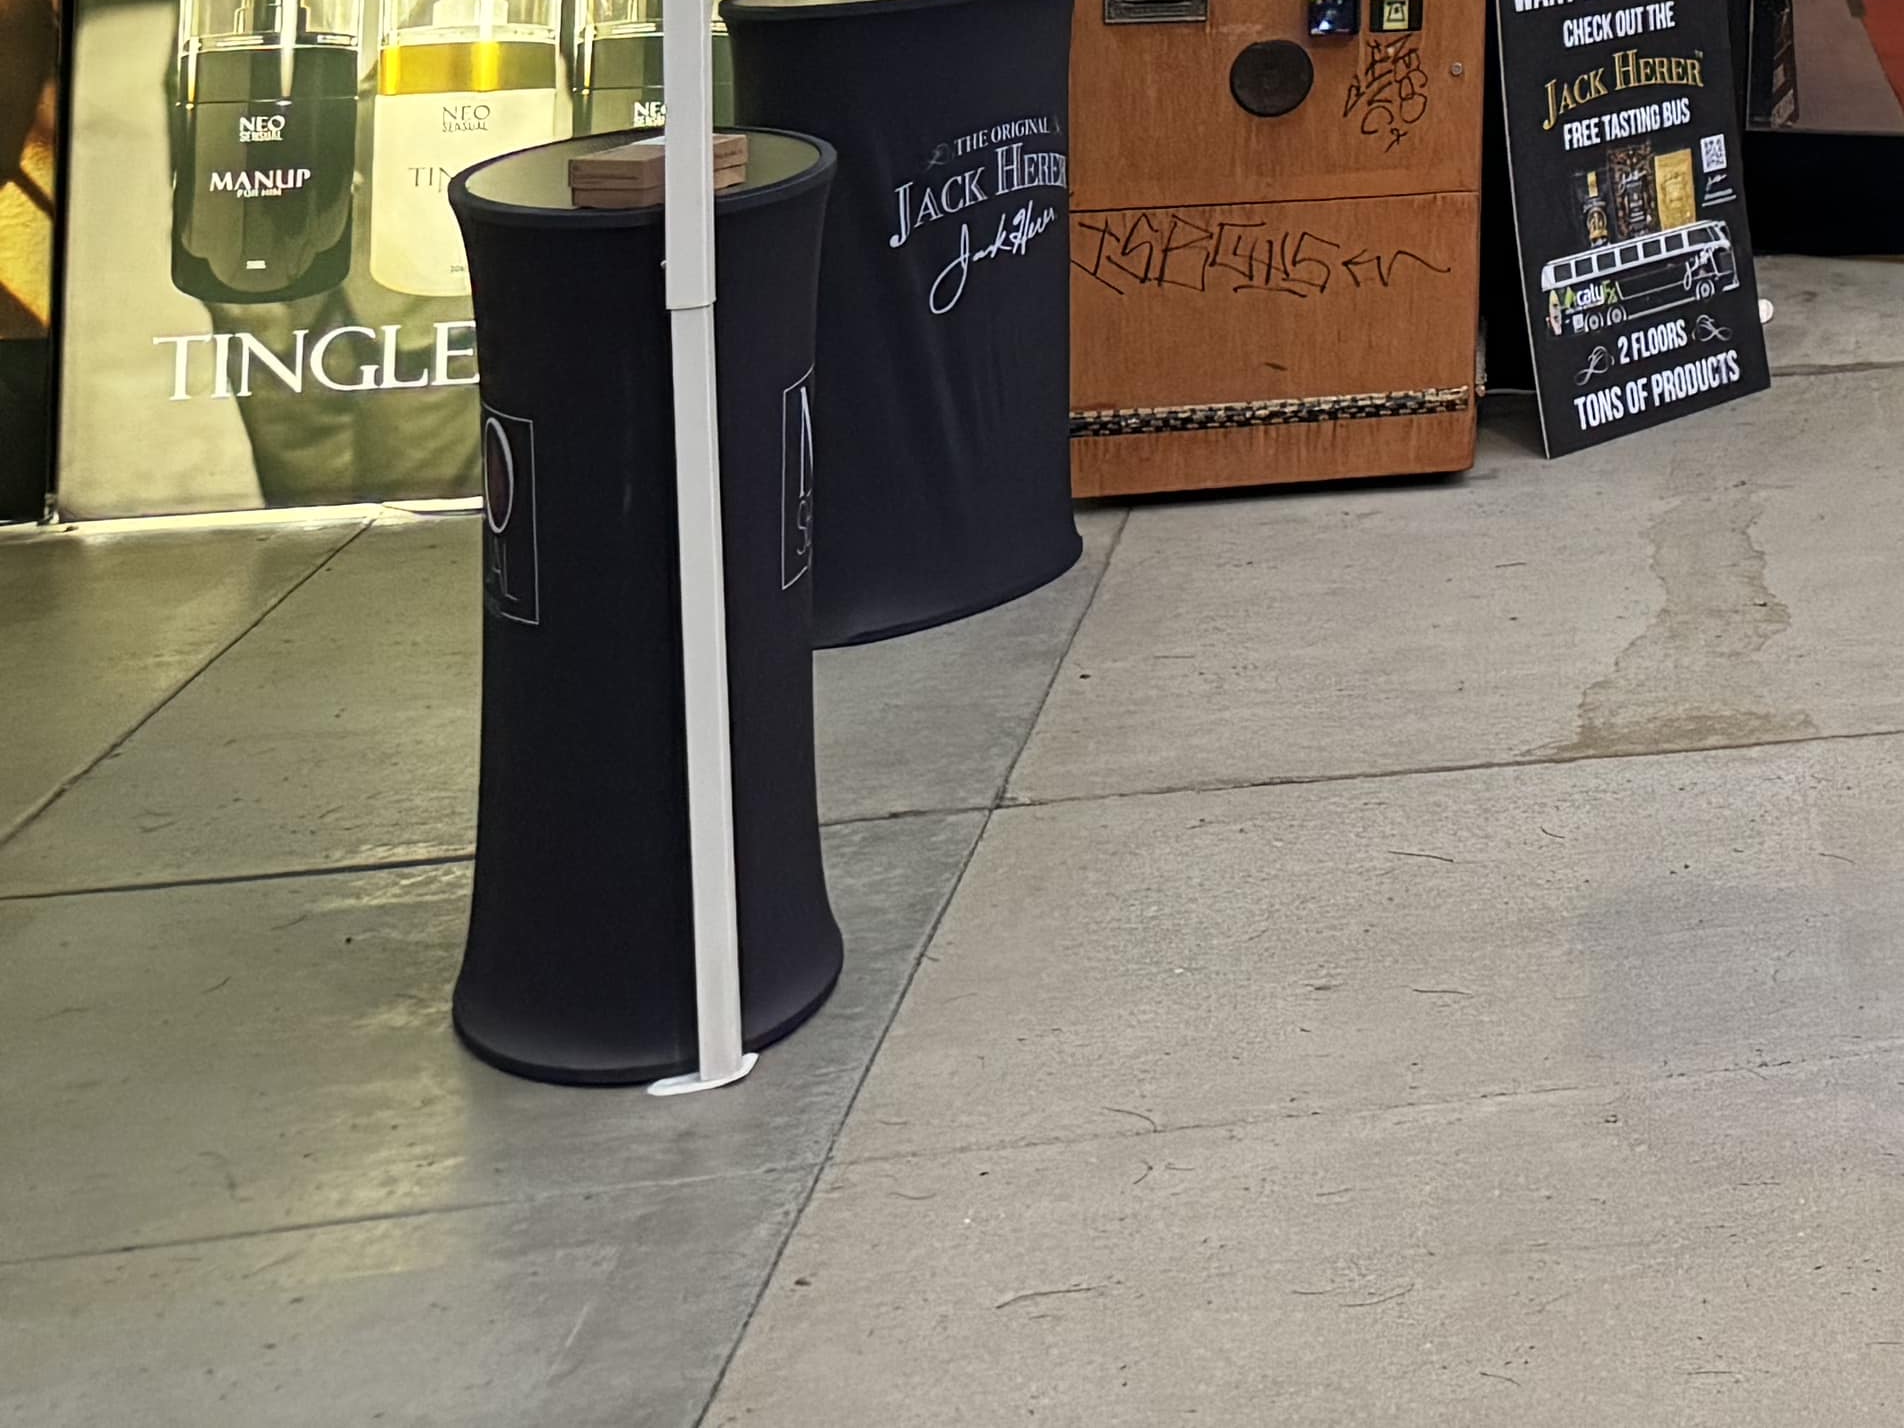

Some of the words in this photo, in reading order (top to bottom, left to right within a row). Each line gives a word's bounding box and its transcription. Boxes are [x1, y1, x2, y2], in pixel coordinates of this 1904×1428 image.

[1563, 13, 1614, 48] CHECK
[1615, 6, 1644, 38] OUT
[1646, 1, 1676, 32] THE
[1542, 67, 1609, 130] JACK
[1612, 49, 1704, 92] HERER
[239, 115, 286, 132] NEO
[955, 131, 989, 157] THE
[991, 116, 1051, 145] ORIGINAL
[1563, 116, 1602, 150] FREE
[1602, 102, 1661, 141] TASTING
[1662, 98, 1691, 129] BUS
[209, 168, 312, 192] MANUP
[889, 167, 989, 248] JACK
[153, 320, 481, 401] TINGLE
[1618, 335, 1630, 365] 2
[1632, 318, 1688, 362] FLOORS
[1574, 387, 1625, 430] TONS
[1626, 377, 1649, 415] OF
[1650, 350, 1741, 407] PRODUCTS
